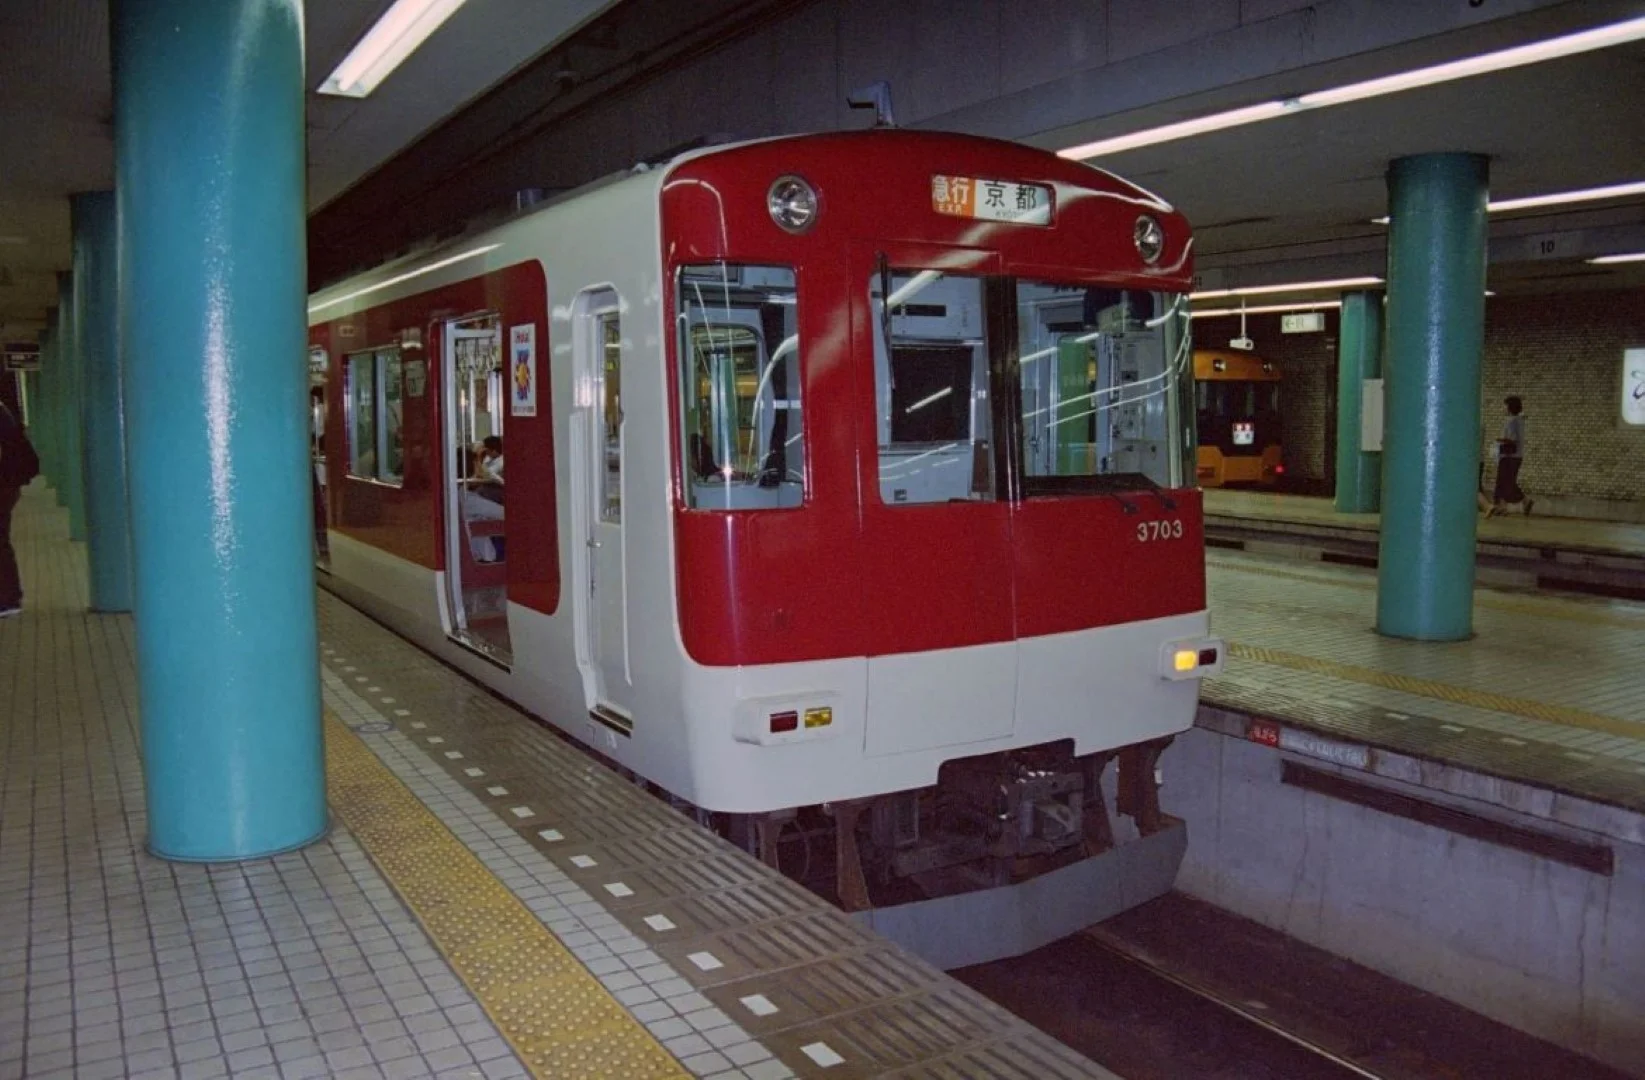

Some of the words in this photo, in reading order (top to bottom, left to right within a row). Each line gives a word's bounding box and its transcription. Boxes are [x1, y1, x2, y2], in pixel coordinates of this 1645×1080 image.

[932, 175, 969, 205] 急行
[984, 180, 1037, 210] 京都
[1541, 240, 1555, 255] 10
[1137, 519, 1183, 542] 3703
